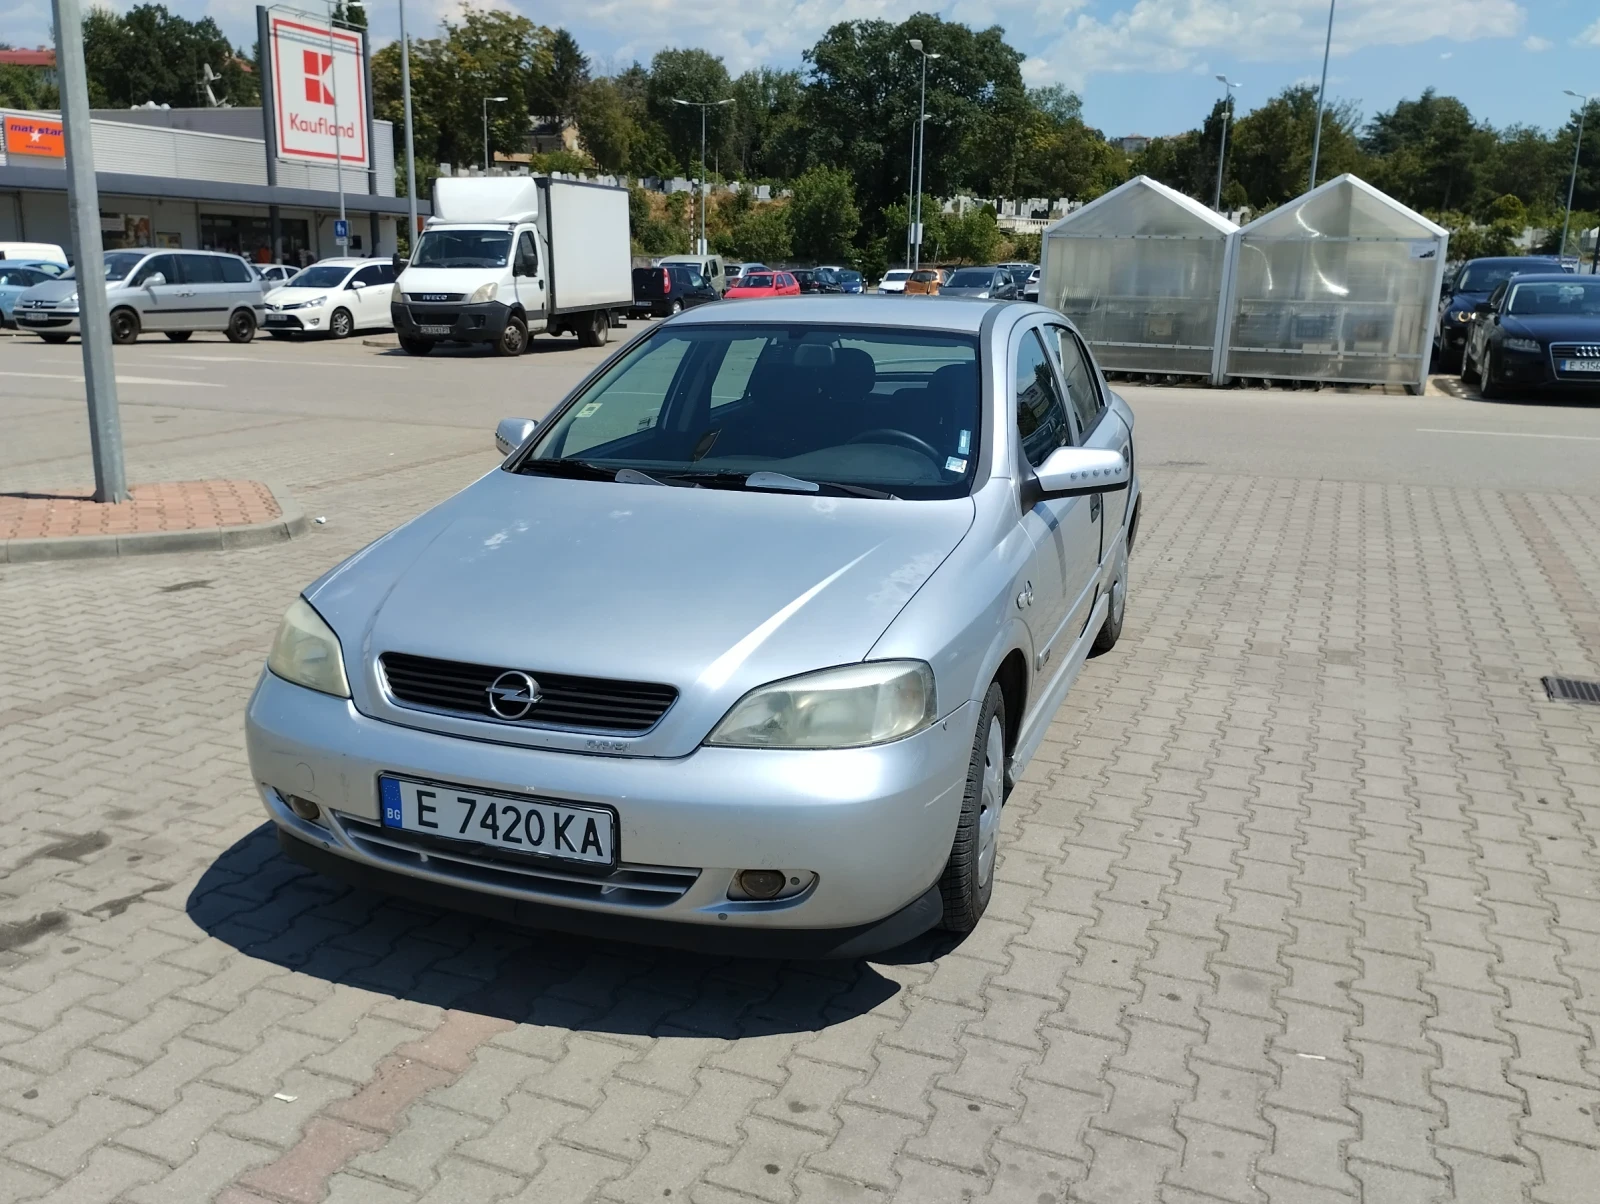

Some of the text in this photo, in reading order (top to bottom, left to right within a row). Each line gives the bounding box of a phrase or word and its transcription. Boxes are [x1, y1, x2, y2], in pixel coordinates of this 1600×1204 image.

[10, 124, 34, 134] mat
[289, 112, 355, 138] Kaufland
[1569, 361, 1576, 370] E
[387, 808, 401, 820] BG
[416, 789, 604, 857] E 7420 KA
